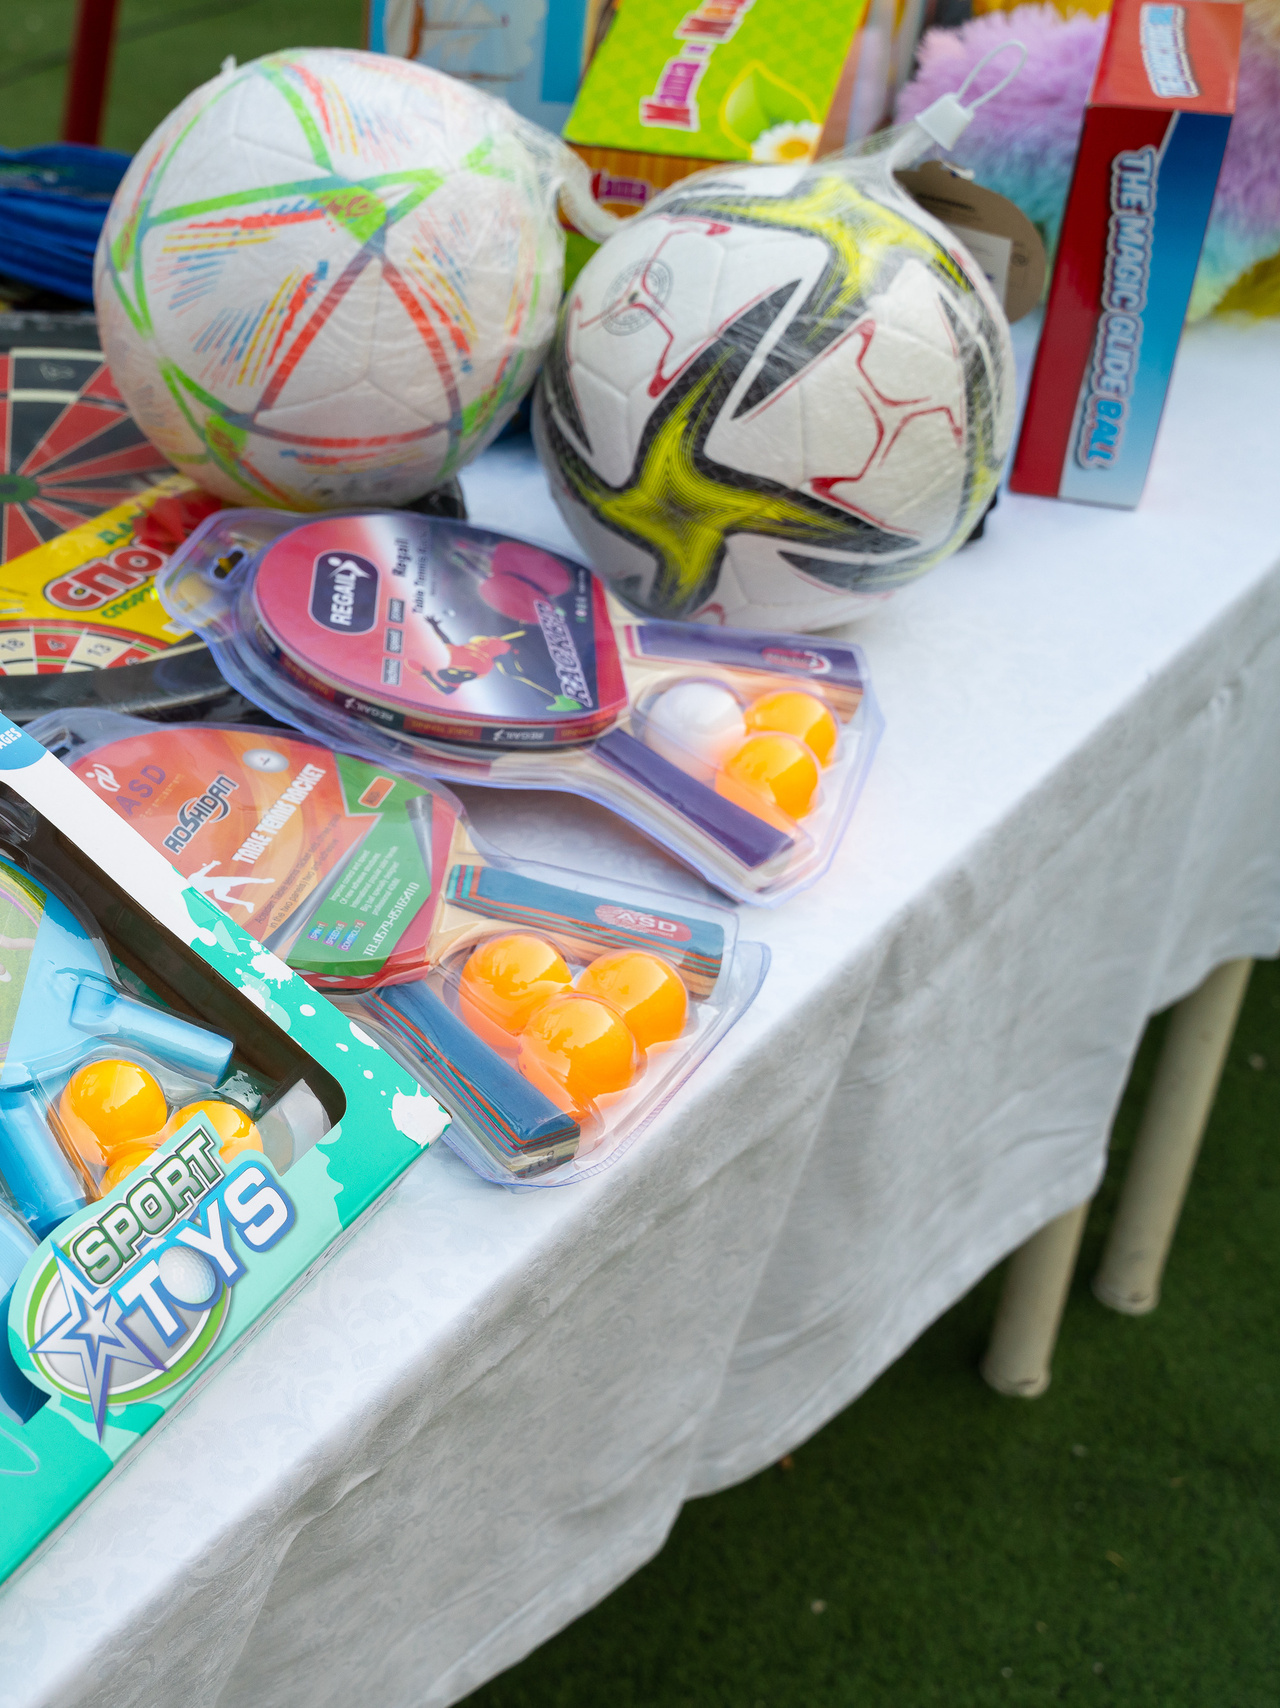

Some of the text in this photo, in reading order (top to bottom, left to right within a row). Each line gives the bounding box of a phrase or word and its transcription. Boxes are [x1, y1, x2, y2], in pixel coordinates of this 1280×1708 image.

[1118, 150, 1155, 213] THE
[1110, 216, 1149, 309] MAGIC
[1086, 399, 1123, 461] BALL
[329, 571, 357, 627] REGAIL
[533, 600, 593, 708] RACKET
[116, 764, 166, 817] ASD
[162, 773, 239, 856] AOSHIDAN
[231, 763, 327, 865] TABLE TENNIS RACKET
[616, 911, 679, 933] ASD
[72, 1125, 224, 1286] SPORT
[108, 1160, 295, 1349] TOYS
